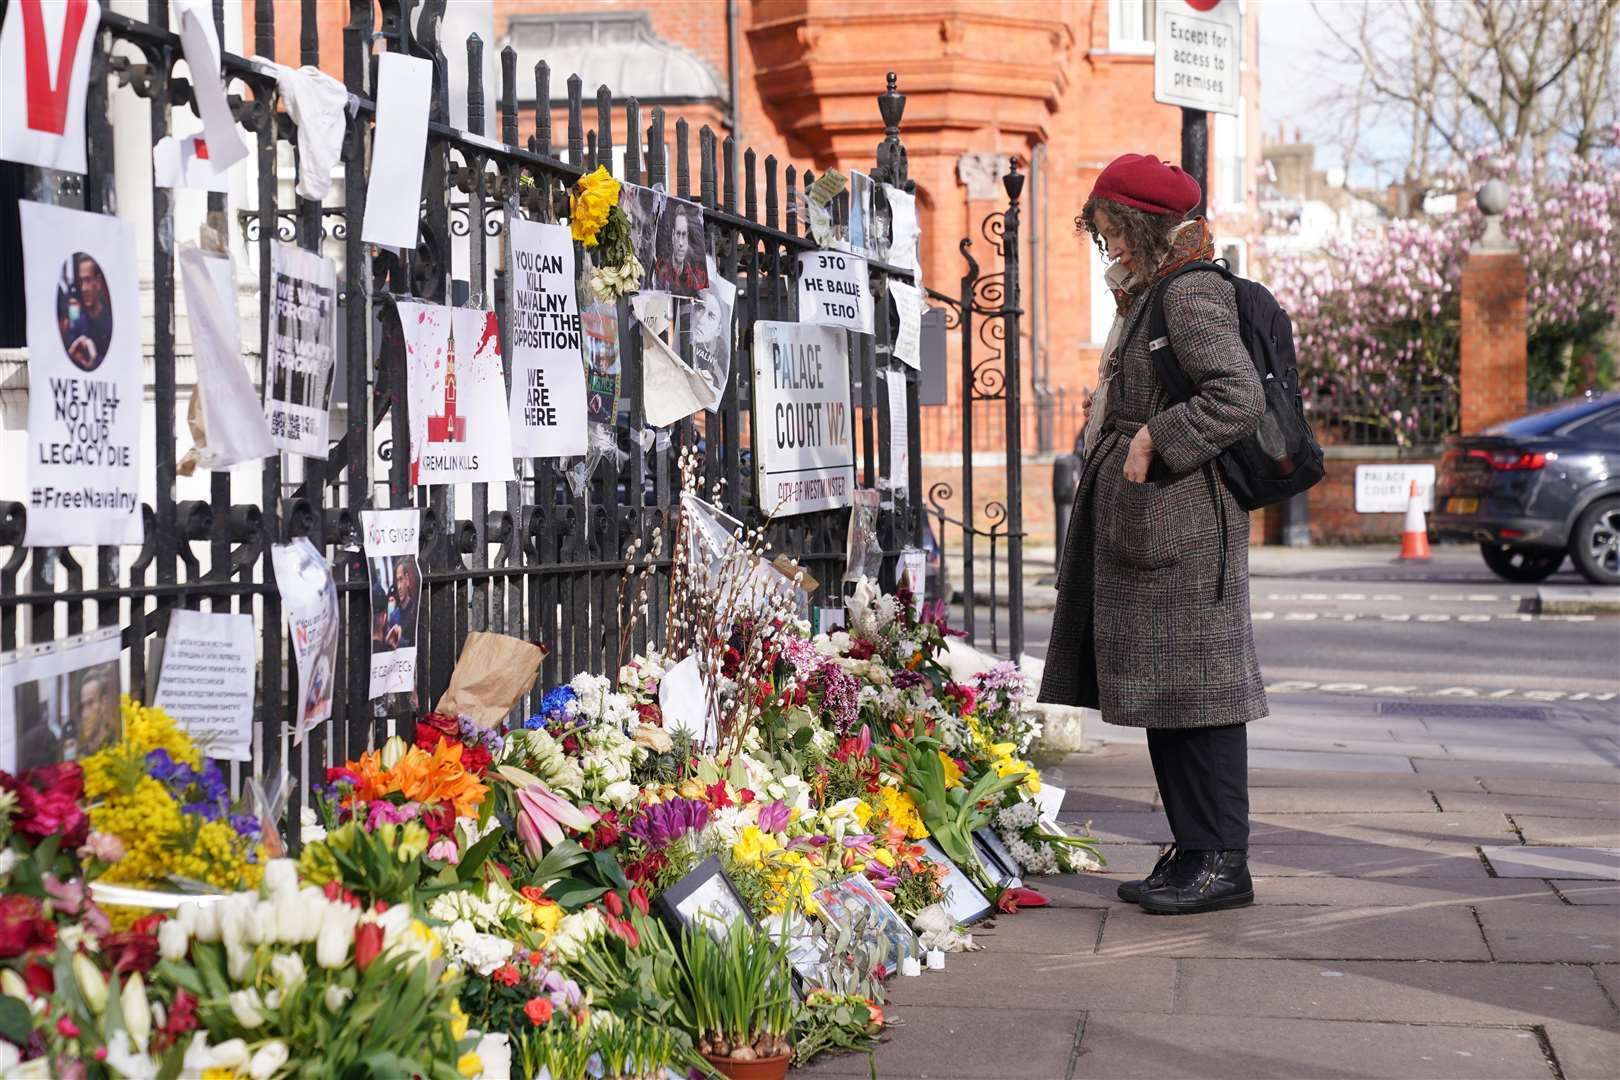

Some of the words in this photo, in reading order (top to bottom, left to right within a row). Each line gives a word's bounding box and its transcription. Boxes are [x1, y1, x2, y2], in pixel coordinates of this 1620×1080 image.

[1170, 21, 1208, 46] Except
[1212, 30, 1227, 48] for
[1173, 49, 1209, 68] access
[1214, 55, 1225, 71] to
[1174, 72, 1224, 93] premises
[515, 250, 533, 271] YOU
[535, 253, 563, 274] CAN
[818, 255, 846, 270] ЭТО
[526, 271, 546, 292] KILL
[804, 278, 824, 291] НЕ
[826, 280, 860, 297] ВАШЕ
[517, 290, 568, 313] NAVALNY
[823, 302, 855, 319] ТЕЛО
[514, 309, 526, 329] BUT
[527, 311, 546, 330] NOT
[550, 313, 580, 331] THE
[513, 329, 579, 349] OPPOSITION
[772, 342, 824, 390] PALACE
[527, 368, 545, 387] WE
[49, 378, 79, 401] WE
[84, 380, 120, 403] WILL
[526, 388, 550, 407] ARE
[55, 400, 88, 422] NOT
[93, 402, 118, 424] LET
[524, 407, 557, 426] HERE
[66, 421, 109, 444] YOUR
[775, 402, 822, 450] COURT
[826, 402, 848, 447] W2
[39, 442, 104, 466] LEGACY
[107, 445, 130, 467] DIE
[31, 487, 137, 514] #FreeNavalny
[778, 482, 793, 503] CITY
[794, 481, 802, 502] OF
[804, 476, 846, 500] WESTMINSTER
